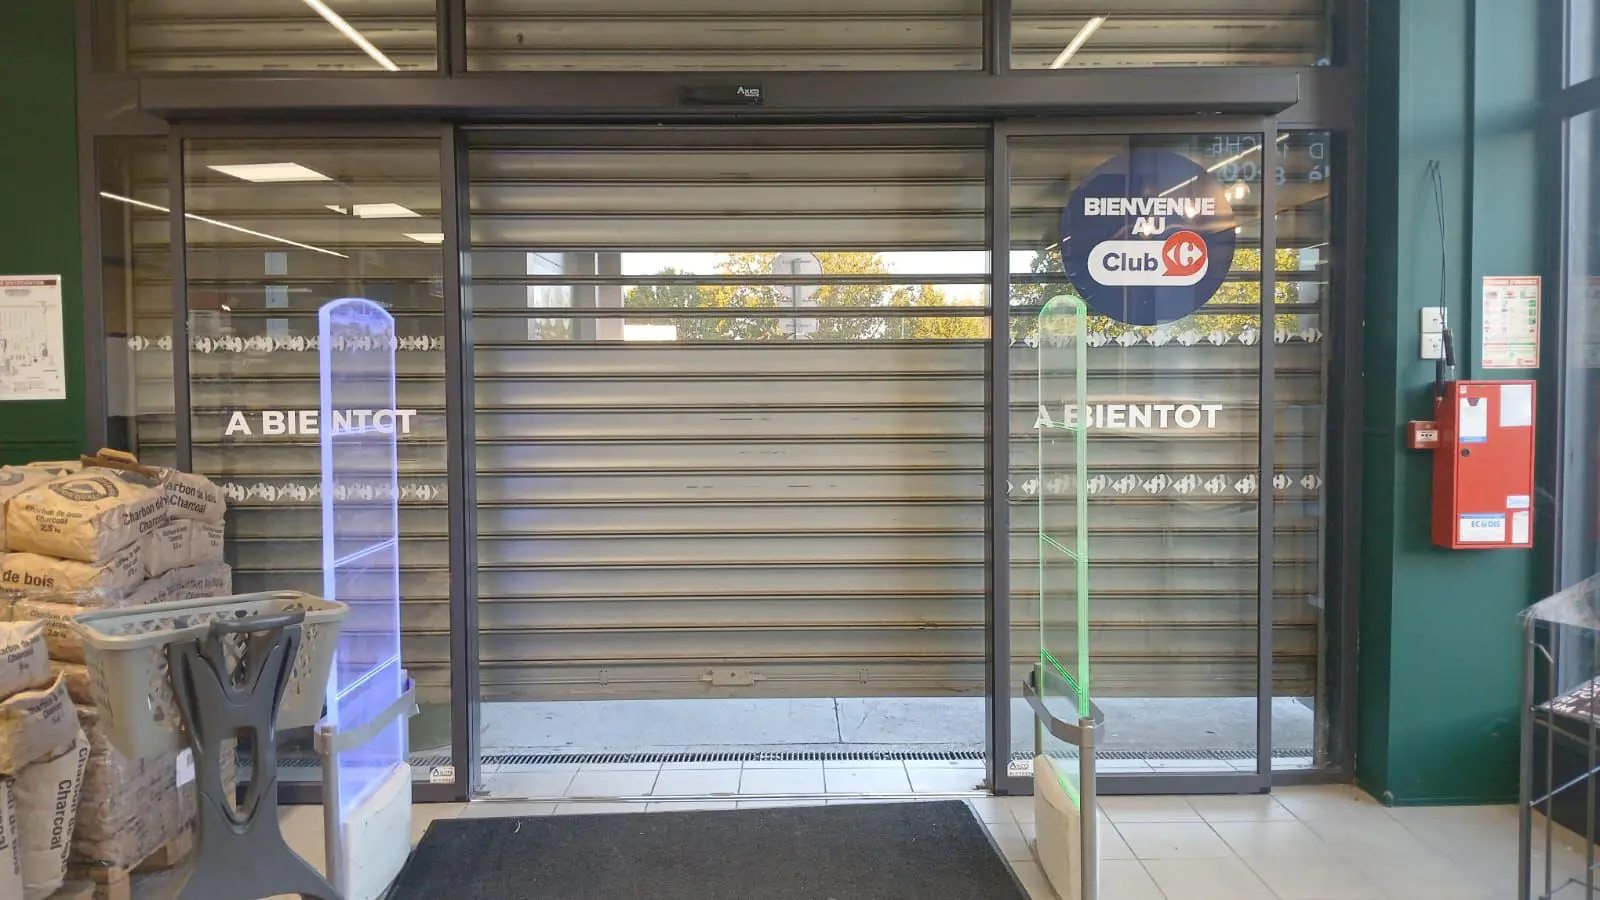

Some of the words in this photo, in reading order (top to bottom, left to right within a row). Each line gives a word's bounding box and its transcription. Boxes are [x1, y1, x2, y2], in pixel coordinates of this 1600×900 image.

[1084, 197, 1215, 216] BIENVENUE
[1131, 216, 1166, 235] AU
[1102, 252, 1159, 272] Club
[224, 410, 252, 436] A
[262, 409, 417, 435] BIENTOT
[1033, 404, 1056, 429] A
[1064, 404, 1223, 429] BIENTOT
[169, 494, 207, 514] Charcoal
[122, 503, 156, 526] Charbon
[2, 569, 20, 583] de
[24, 571, 55, 588] bois
[50, 779, 72, 850] Charcoal
